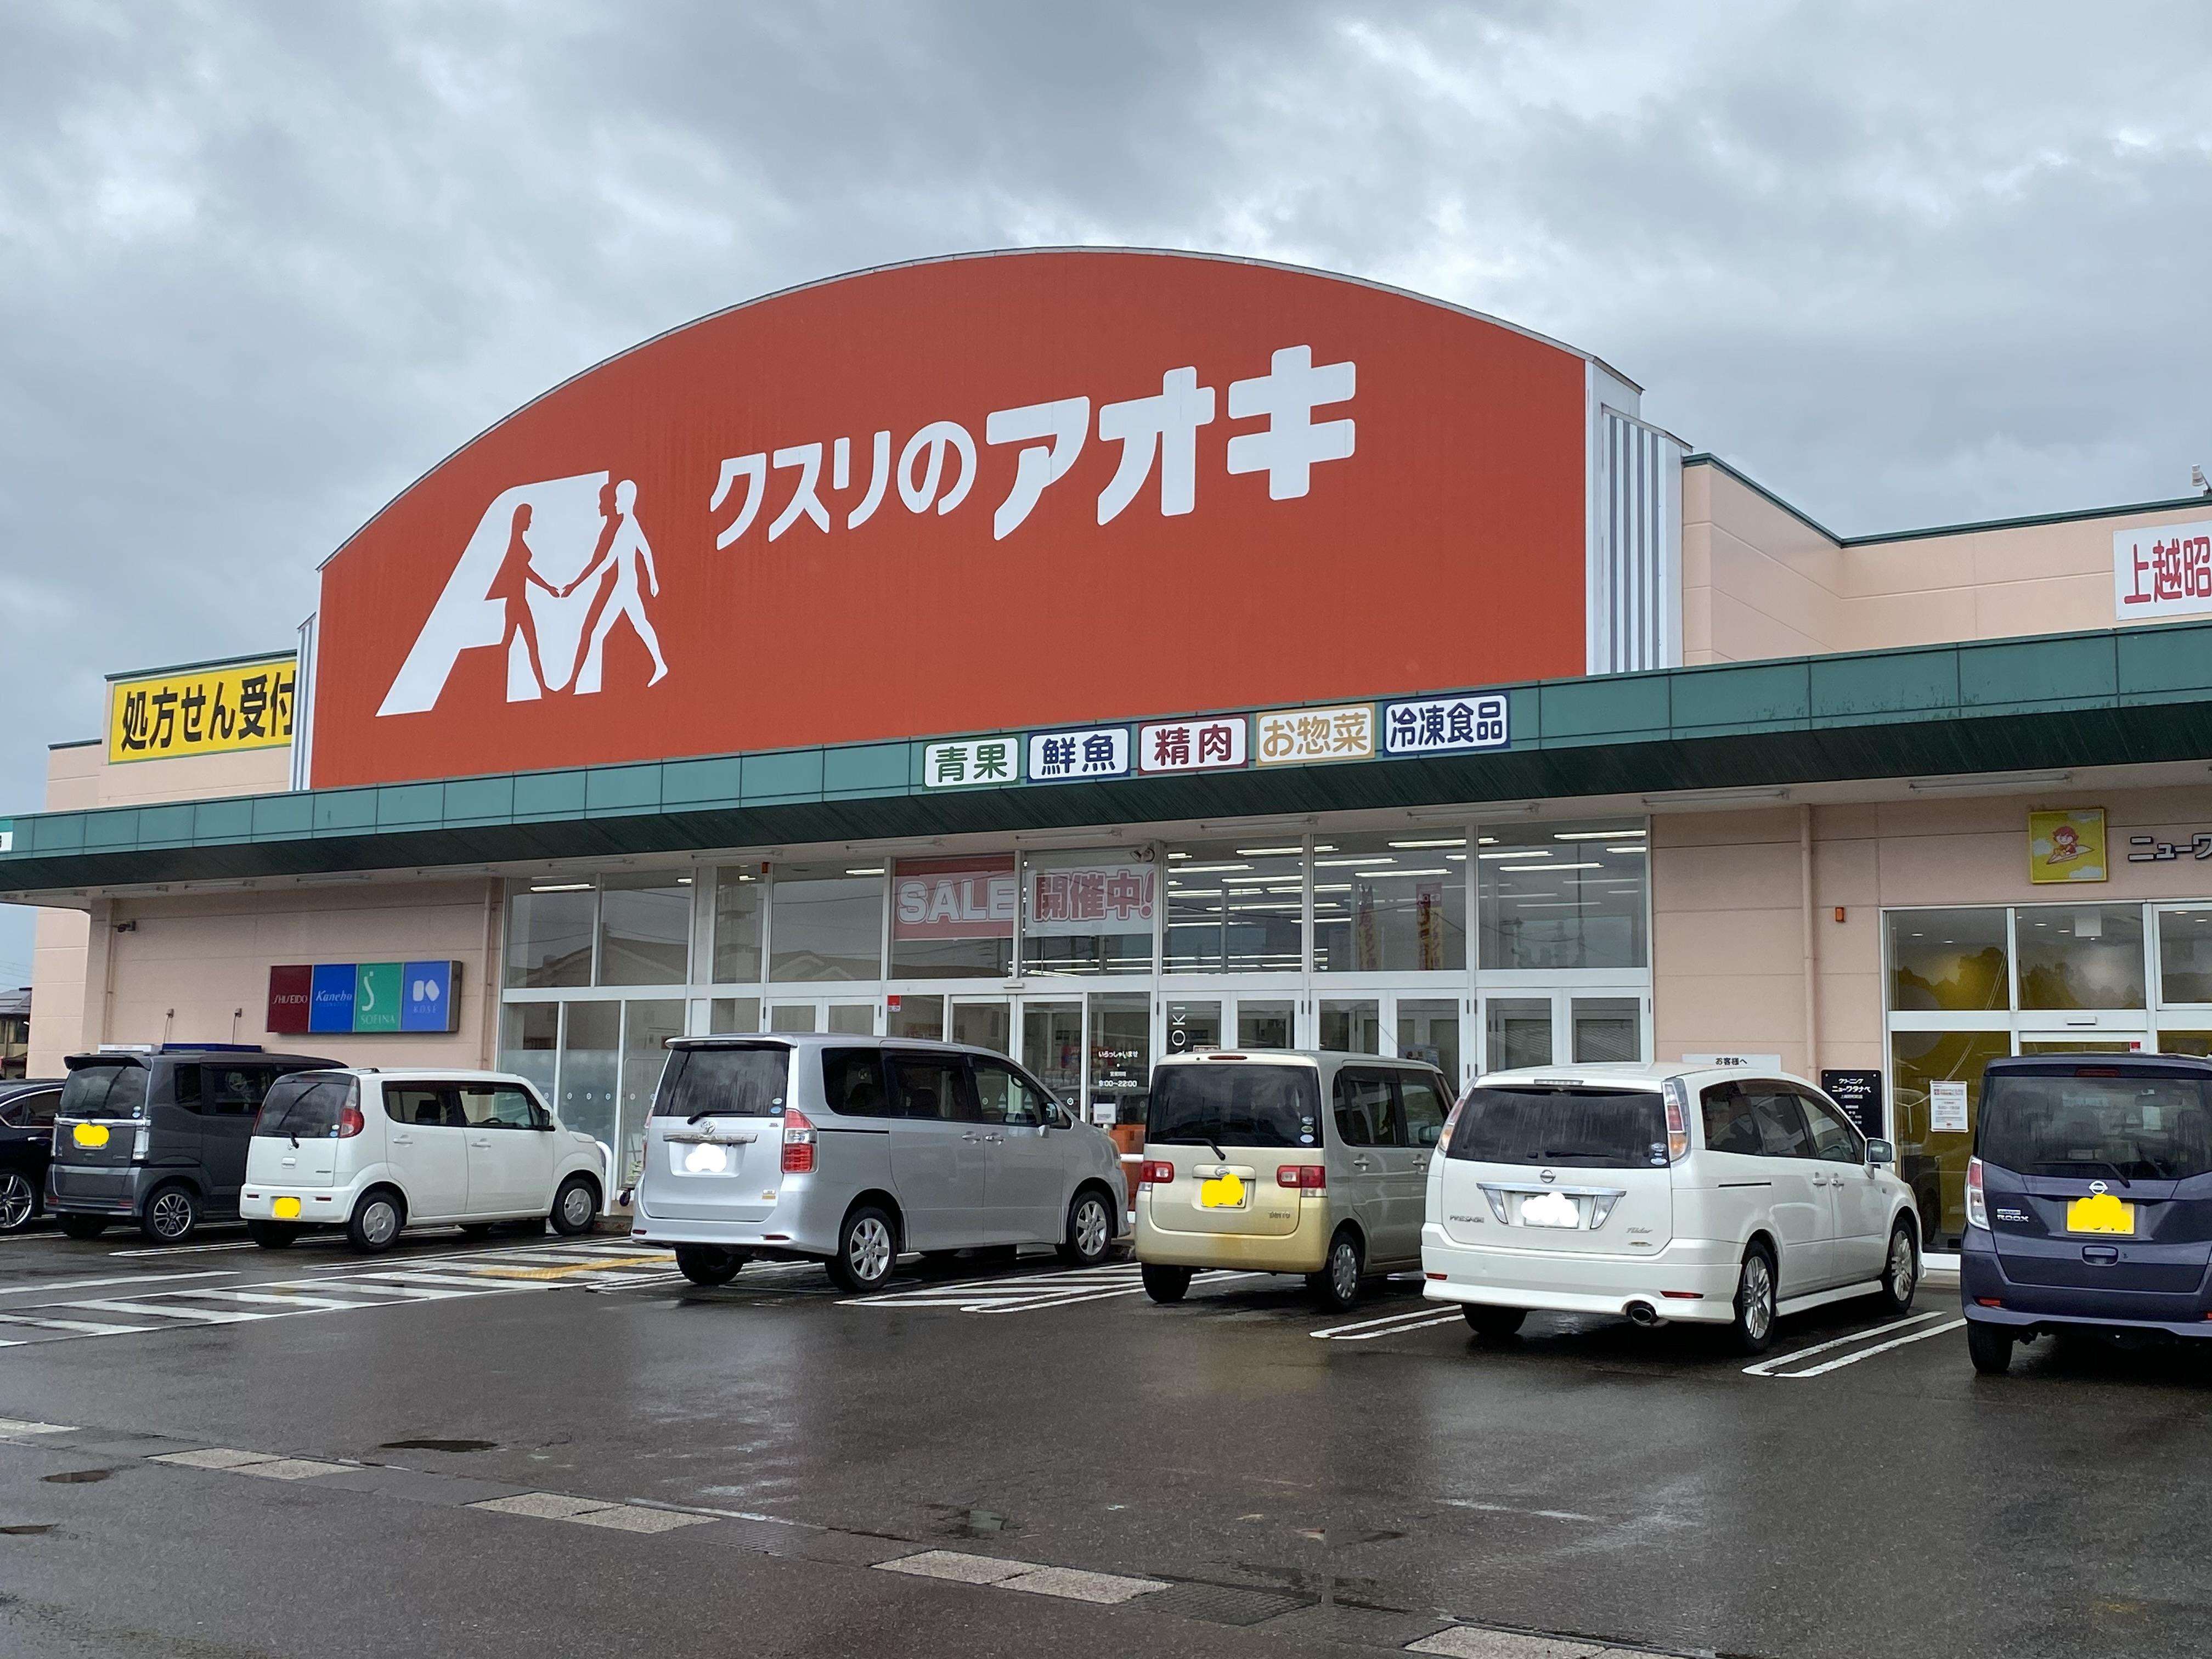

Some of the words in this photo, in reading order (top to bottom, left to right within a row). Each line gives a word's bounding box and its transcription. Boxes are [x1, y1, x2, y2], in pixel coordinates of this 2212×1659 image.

[710, 345, 1356, 551] クスリのアオキ
[2124, 536, 2212, 605] 上越昭
[1153, 723, 1232, 766] 精肉
[1263, 712, 1368, 757] お惣菜
[1390, 701, 1503, 748] 冷凍食品
[934, 744, 1008, 783] 青果
[1041, 733, 1116, 776] 鮮魚
[898, 879, 1014, 924] SALE
